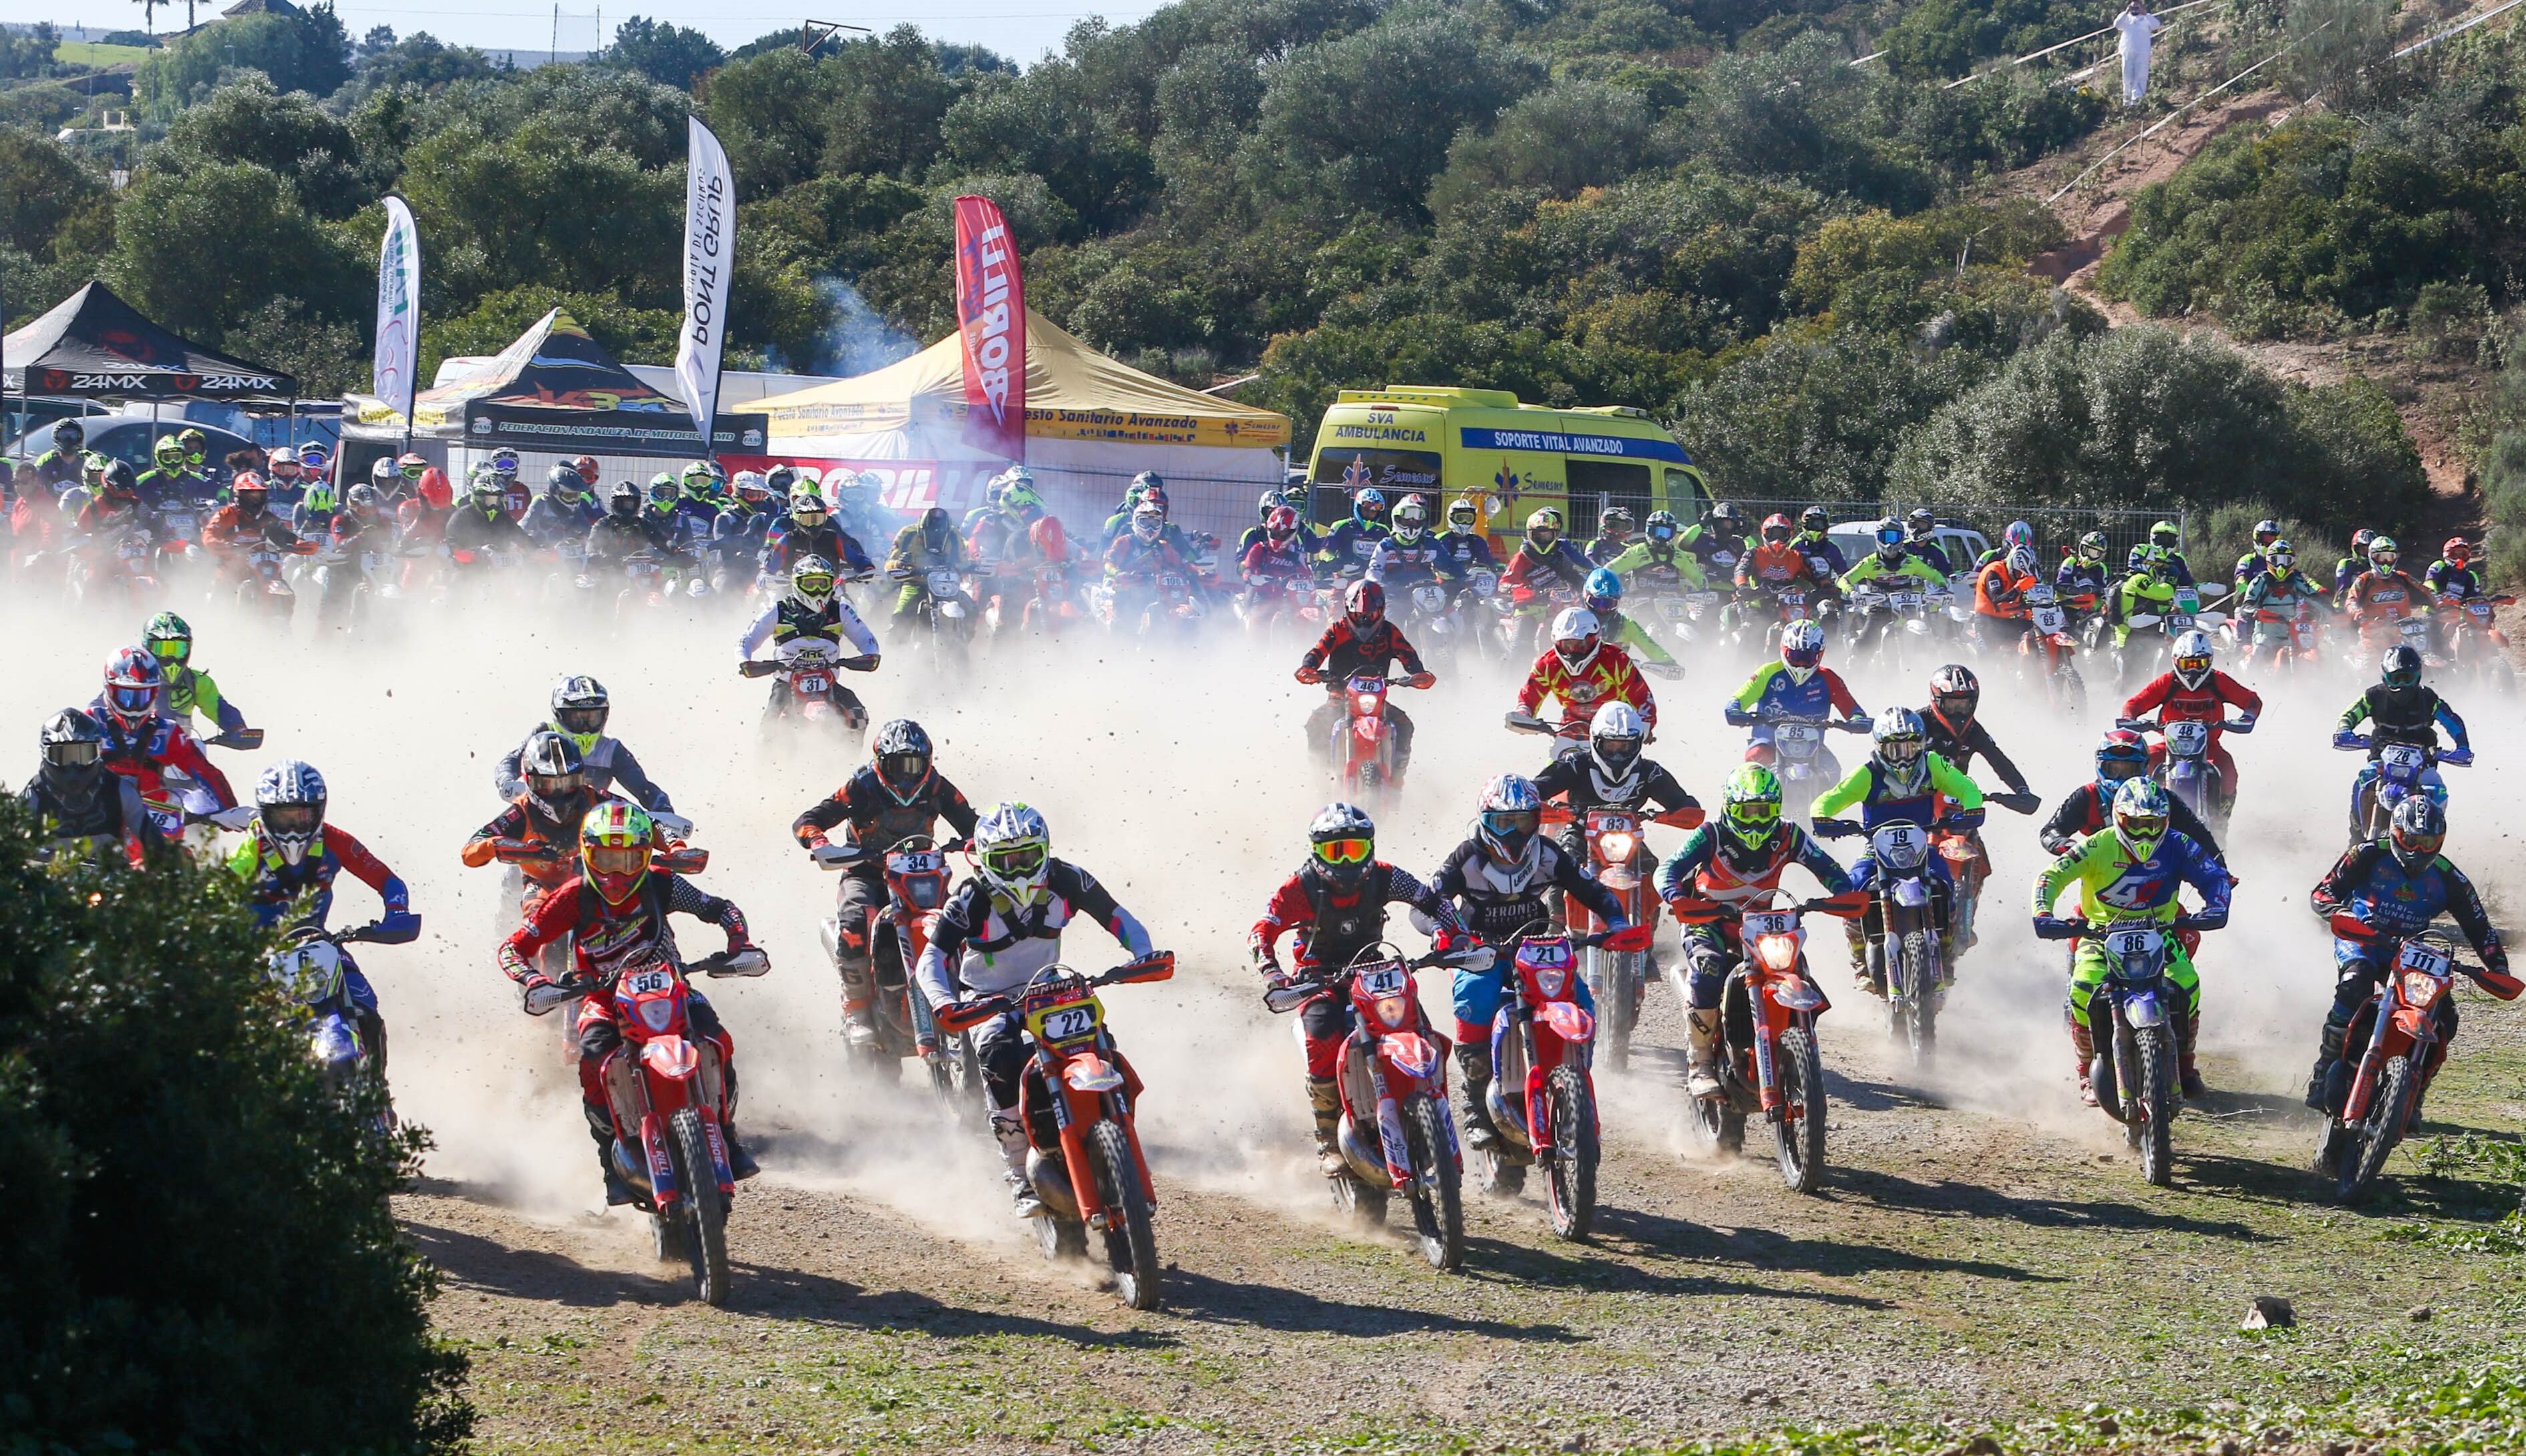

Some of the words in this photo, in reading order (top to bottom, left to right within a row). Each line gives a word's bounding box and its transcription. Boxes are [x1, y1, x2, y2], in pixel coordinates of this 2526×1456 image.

[71, 375, 147, 390] 24MX
[200, 375, 277, 390] 24MX
[797, 405, 828, 419] Sanitario
[1025, 411, 1054, 421] esto
[1059, 409, 1124, 426] Sanitario
[1128, 413, 1197, 429] Avanzado
[1367, 412, 1394, 424] SVA
[499, 421, 568, 435] FEDERACION
[568, 425, 632, 437] ANDALUZA
[635, 428, 650, 436] DE
[651, 429, 735, 441] MOTOCICLMO
[1335, 425, 1425, 443] AMBULANCIA
[1495, 430, 1540, 450] SOPORTE
[1543, 433, 1571, 452] VITAL
[1573, 435, 1624, 455] AVANZADO
[1789, 595, 1799, 603] 64
[2043, 614, 2054, 624] 69
[806, 679, 820, 691] 31
[1360, 681, 1375, 692] 46
[1789, 726, 1804, 738] 85
[2178, 725, 2193, 736] 48
[2394, 750, 2410, 762] 28
[153, 812, 168, 827] 18
[1606, 818, 1624, 830] 83
[1892, 830, 1908, 844] 19
[908, 855, 928, 870] 34
[1485, 901, 1538, 918] SERONES
[1763, 916, 1785, 931] 36
[2123, 935, 2144, 951] 86
[1536, 946, 1555, 962] 21
[2412, 951, 2437, 971] 111
[637, 973, 662, 992] 56
[1374, 972, 1394, 989] 41
[1061, 1011, 1085, 1035] 22
[1766, 1044, 1774, 1086] METZELER
